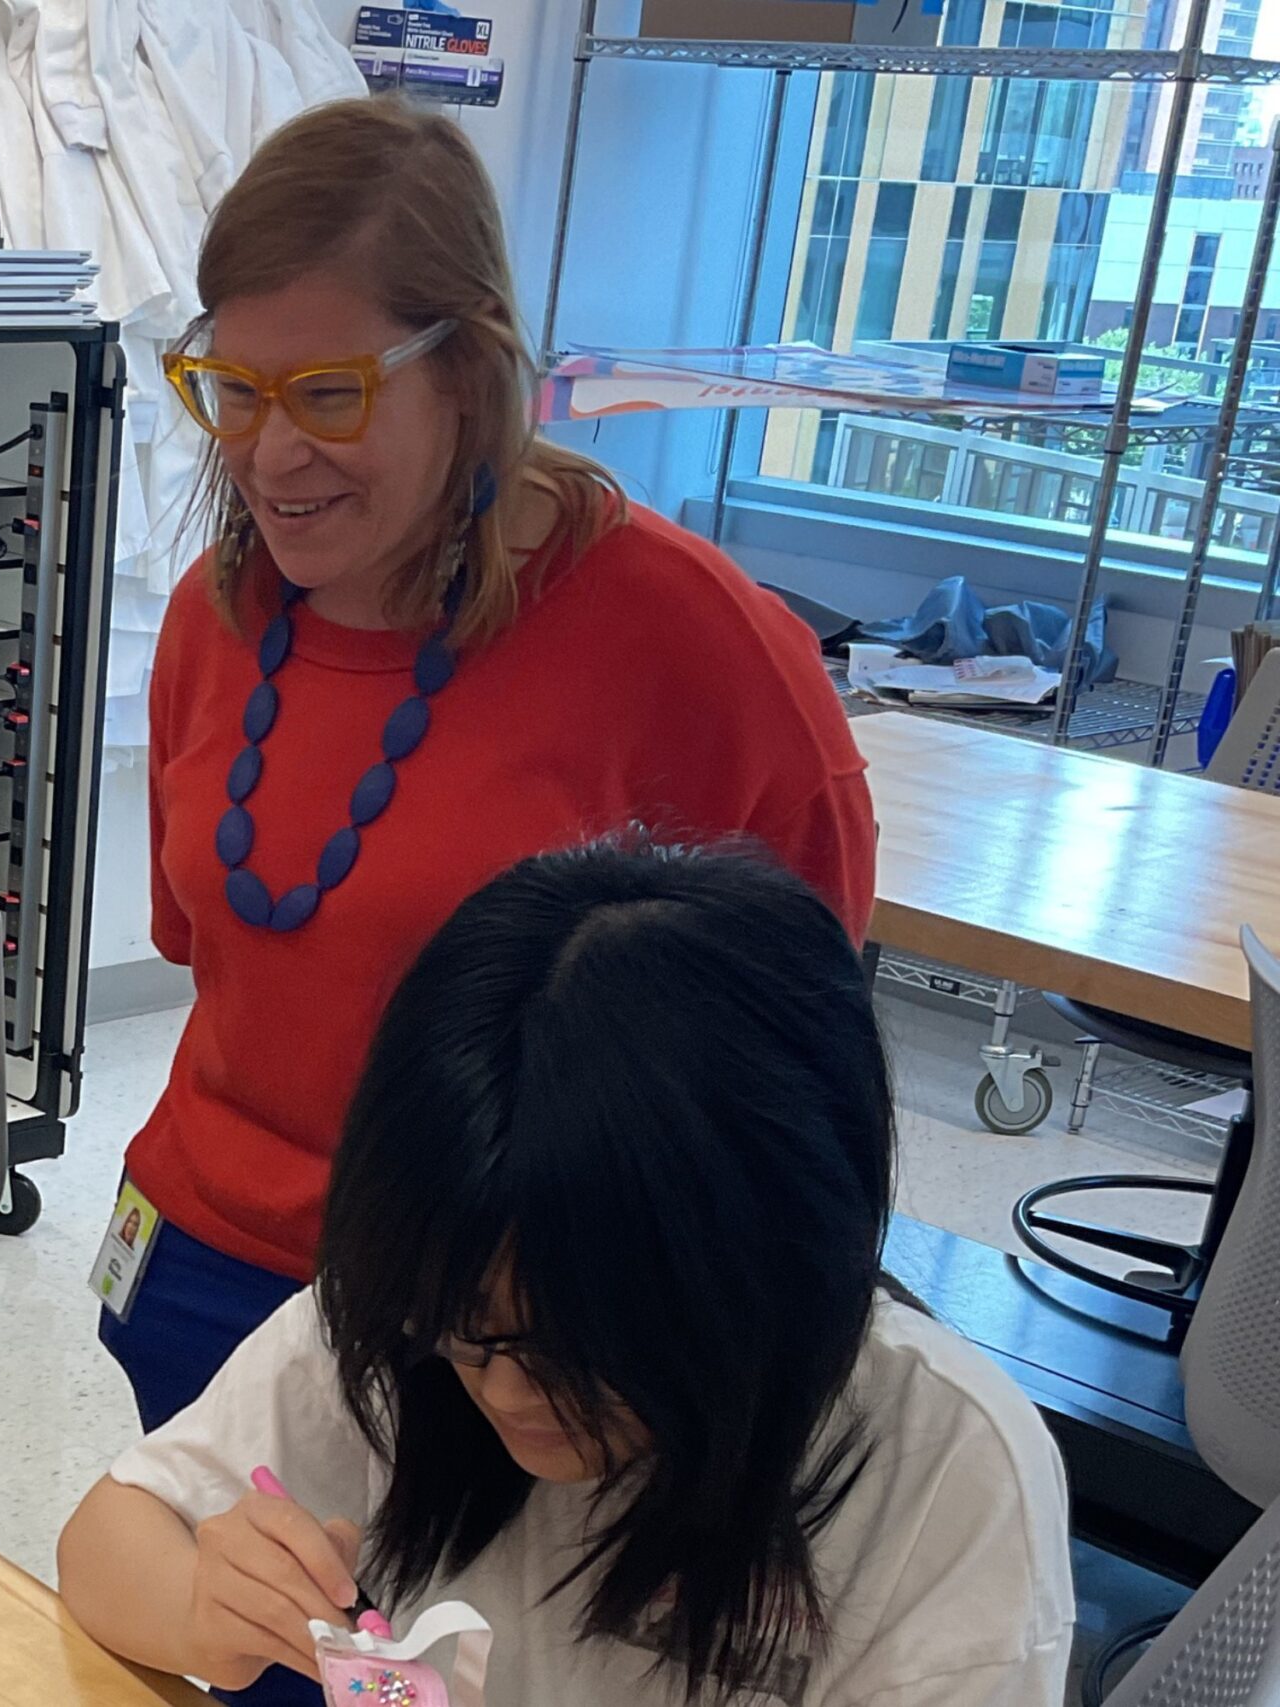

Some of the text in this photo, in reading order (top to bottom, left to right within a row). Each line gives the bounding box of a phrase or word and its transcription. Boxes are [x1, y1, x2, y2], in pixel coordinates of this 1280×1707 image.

[477, 23, 488, 37] XL
[406, 34, 488, 54] NITRILE GLOVES
